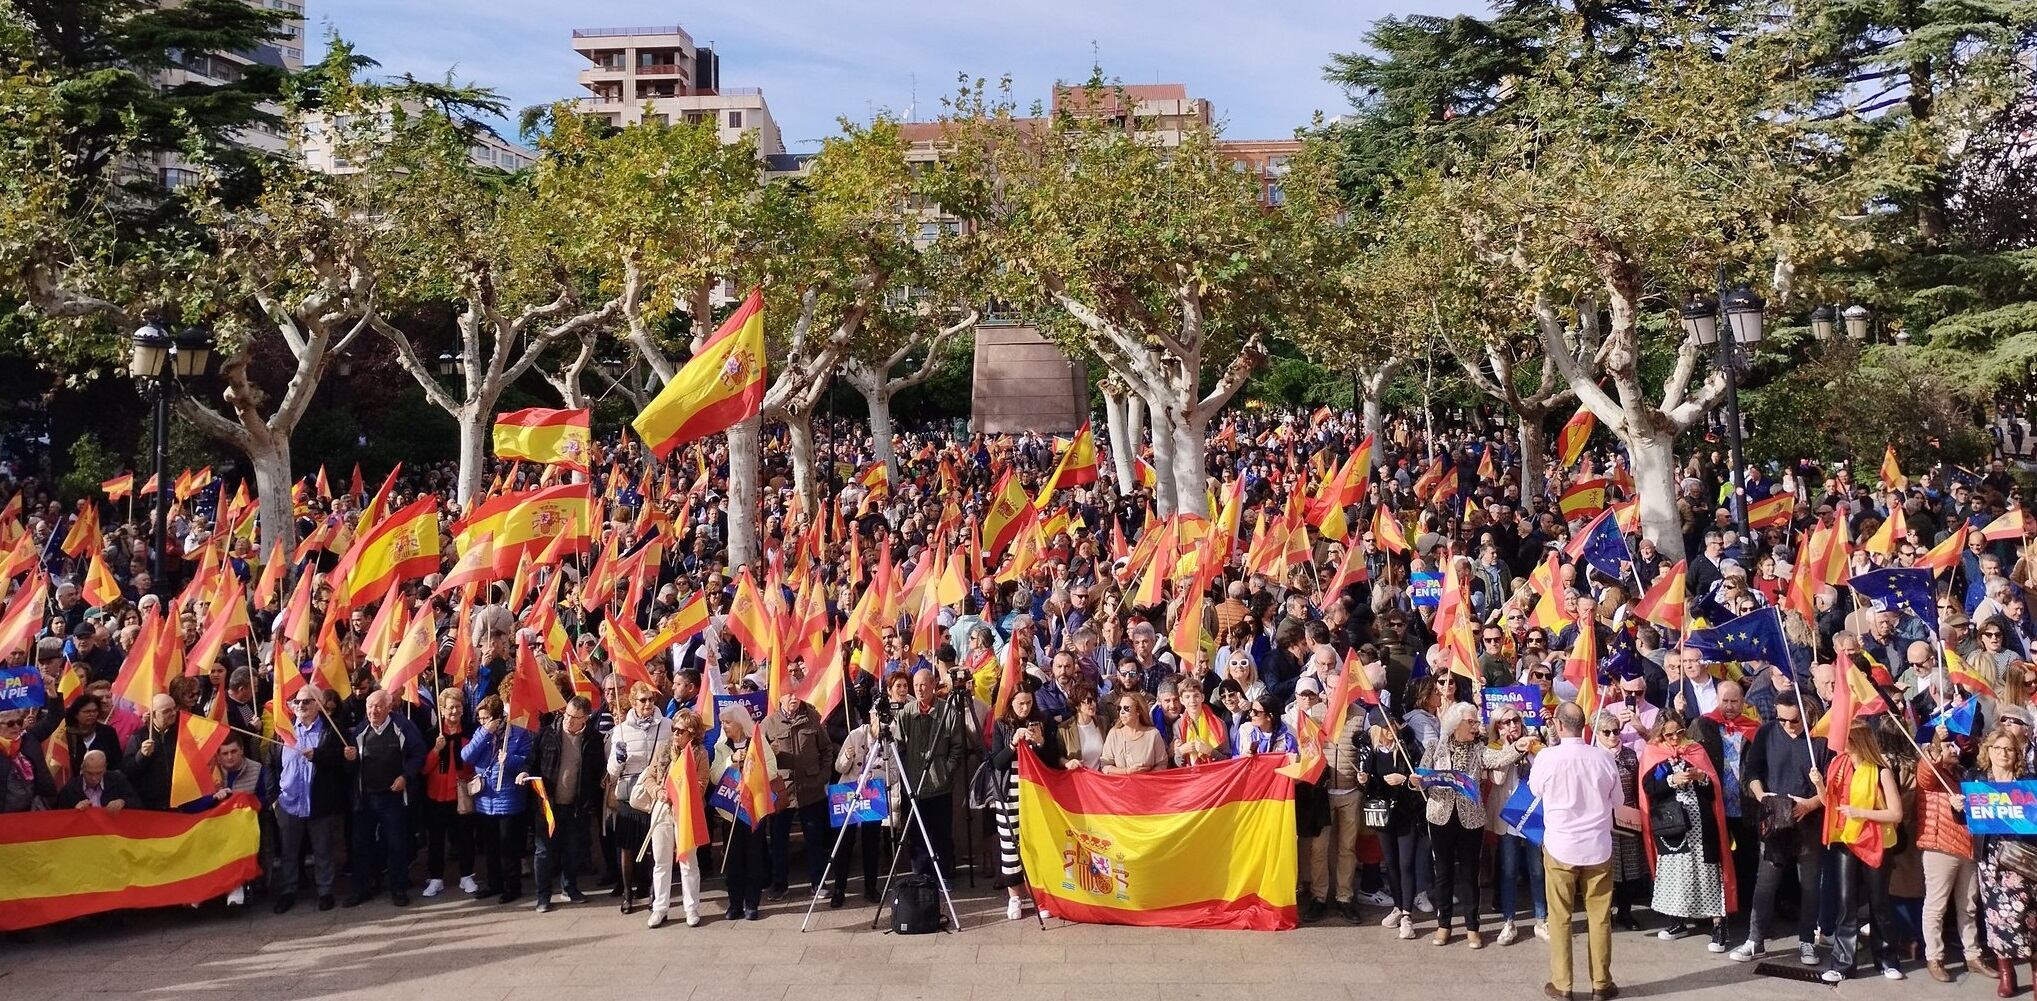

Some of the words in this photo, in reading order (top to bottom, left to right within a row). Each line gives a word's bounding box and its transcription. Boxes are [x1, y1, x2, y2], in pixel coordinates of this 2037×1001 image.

[1416, 580, 1440, 588] ESPA
[1416, 588, 1429, 596] EN
[1431, 588, 1442, 596] PI
[8, 686, 28, 699] PIE
[1485, 692, 1524, 702] ESPAÑA
[1486, 702, 1499, 710] EN
[717, 785, 735, 799] EN
[1969, 789, 2037, 805] ESPAÑA
[834, 803, 849, 814] EN
[853, 800, 871, 811] PIE
[1971, 806, 1994, 819] EN
[1997, 806, 2025, 819] PIE
